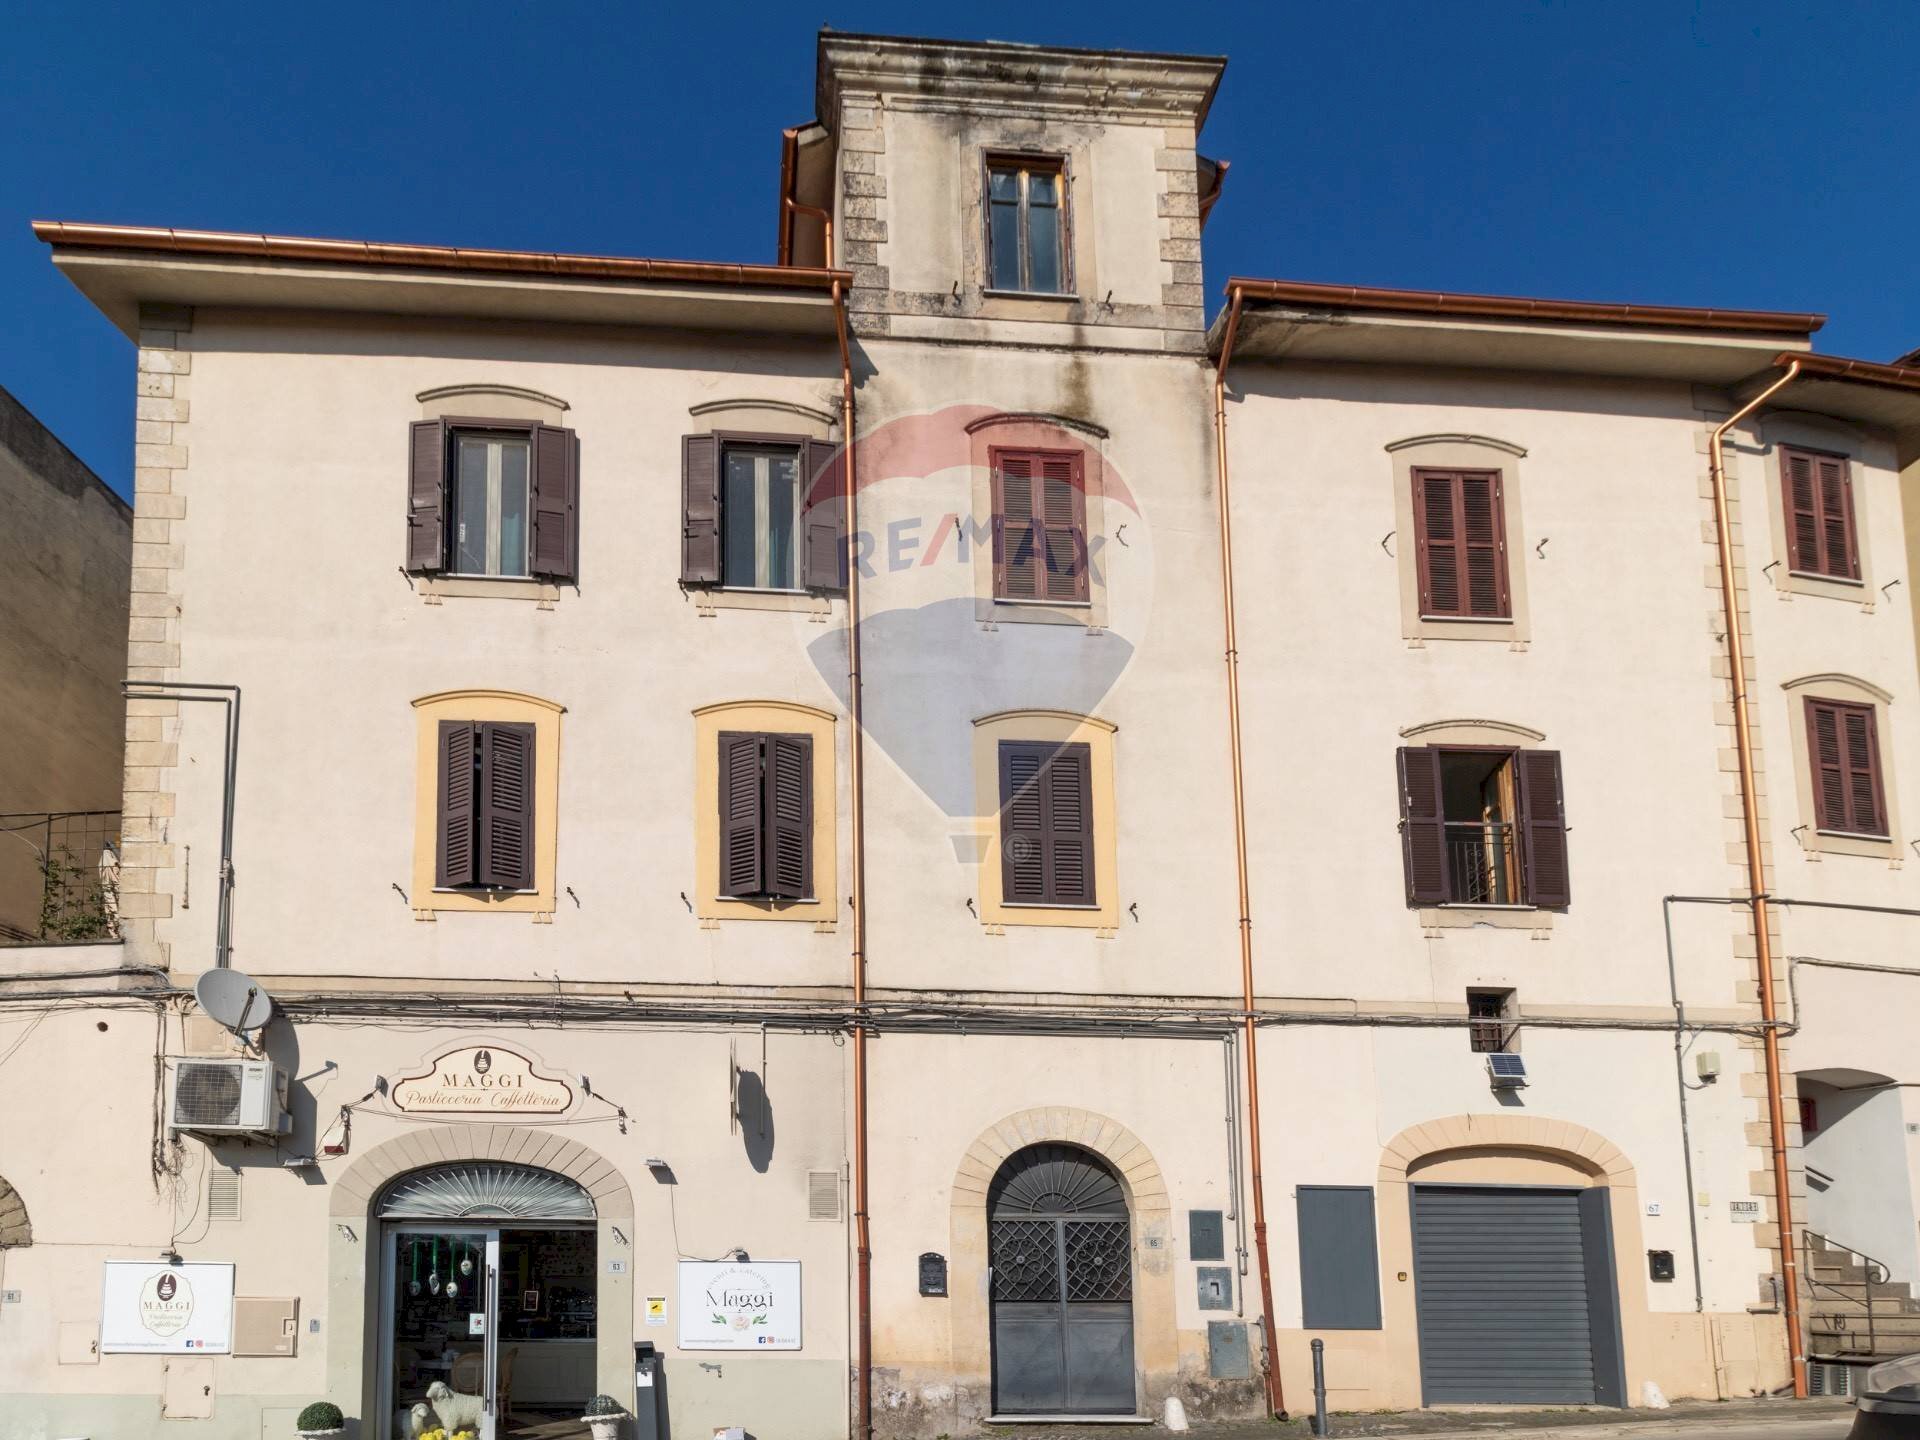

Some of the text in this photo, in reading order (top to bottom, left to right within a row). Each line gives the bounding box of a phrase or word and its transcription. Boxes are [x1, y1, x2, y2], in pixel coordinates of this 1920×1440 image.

[442, 1073, 523, 1088] MAGGI
[406, 1091, 559, 1109] Pasticceria Caffetteria
[1648, 1204, 1659, 1213] 67
[144, 1301, 190, 1311] MAGGI
[706, 1289, 774, 1312] Maggi
